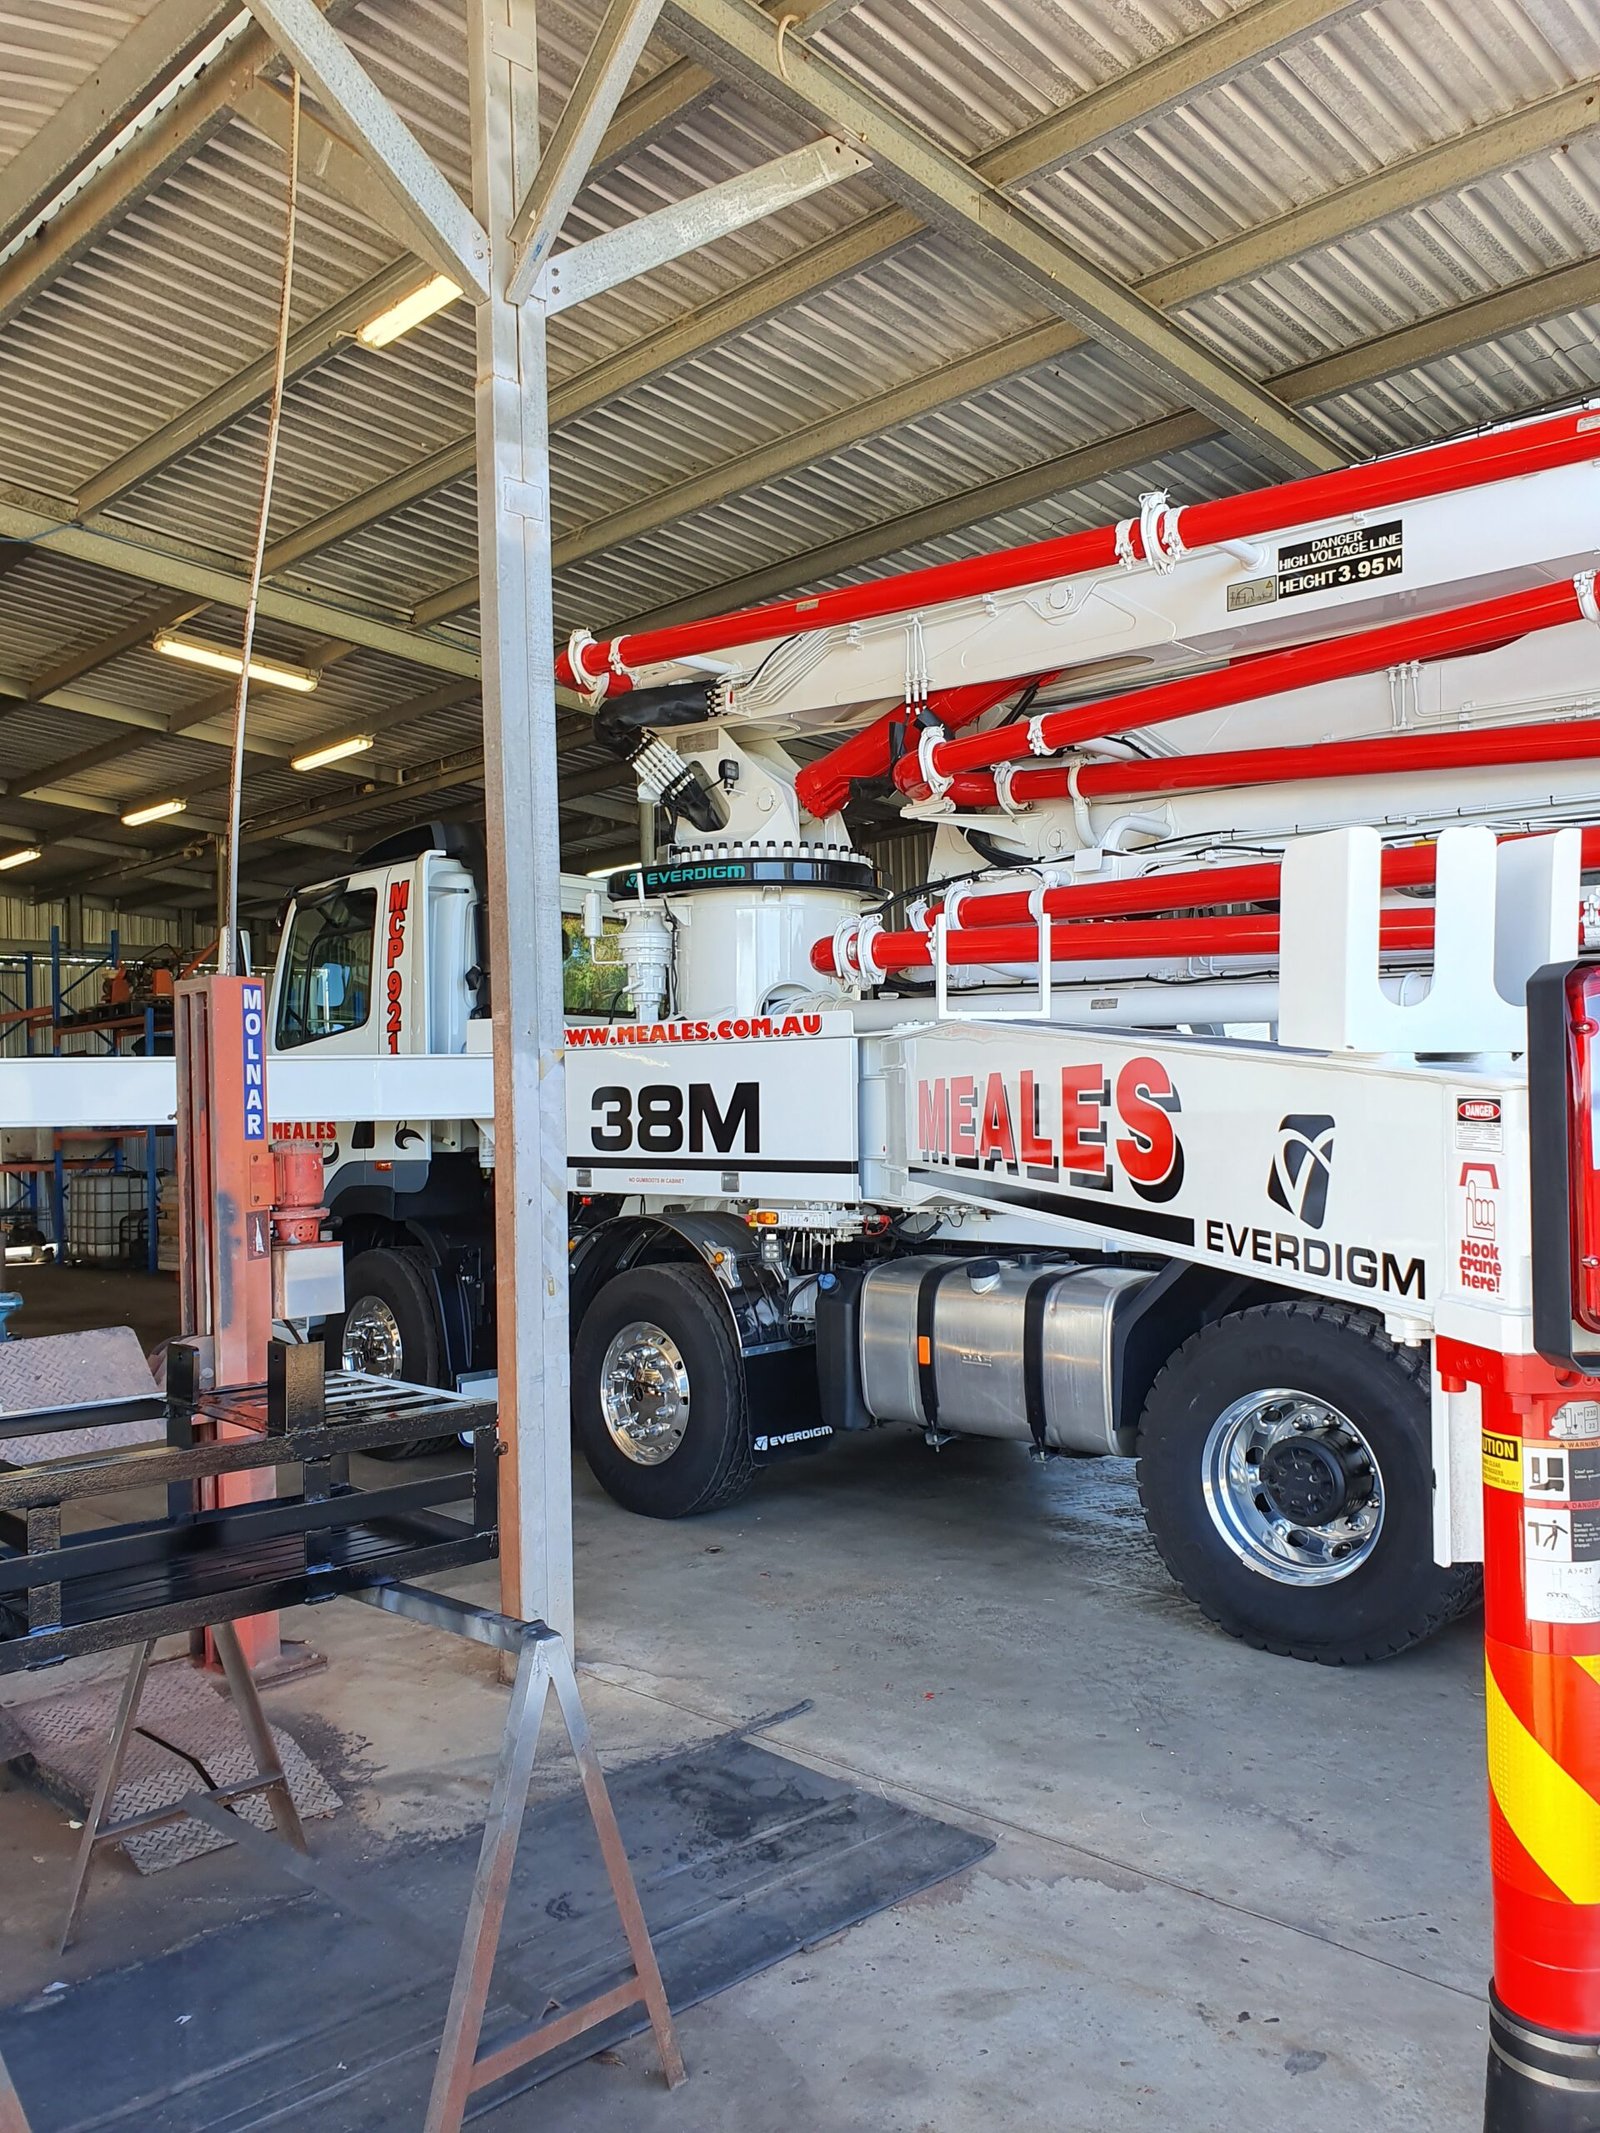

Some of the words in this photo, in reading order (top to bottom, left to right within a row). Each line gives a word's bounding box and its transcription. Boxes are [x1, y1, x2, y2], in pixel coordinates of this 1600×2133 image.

[1279, 552, 1308, 571] HIGH
[1309, 540, 1368, 565] VOLTAGE
[1369, 532, 1402, 550] LINE
[1311, 531, 1363, 552] DANGER
[1279, 569, 1337, 595] HEIGHT
[1338, 557, 1385, 582] 3.95
[1387, 555, 1401, 570] M
[647, 865, 745, 885] EVERDIGM
[243, 988, 262, 1136] MOLNAR
[591, 1082, 760, 1153] 38M
[1465, 1104, 1494, 1117] DANGER
[272, 1122, 336, 1139] MEALES
[918, 1056, 1184, 1202] MEALES
[1206, 1219, 1426, 1300] EVERDIGM
[1461, 1239, 1499, 1260] Hook
[1460, 1256, 1502, 1276] crane
[1462, 1270, 1500, 1293] here!
[770, 1424, 833, 1447] EVERDIGM
[1483, 1436, 1515, 1459] UTION
